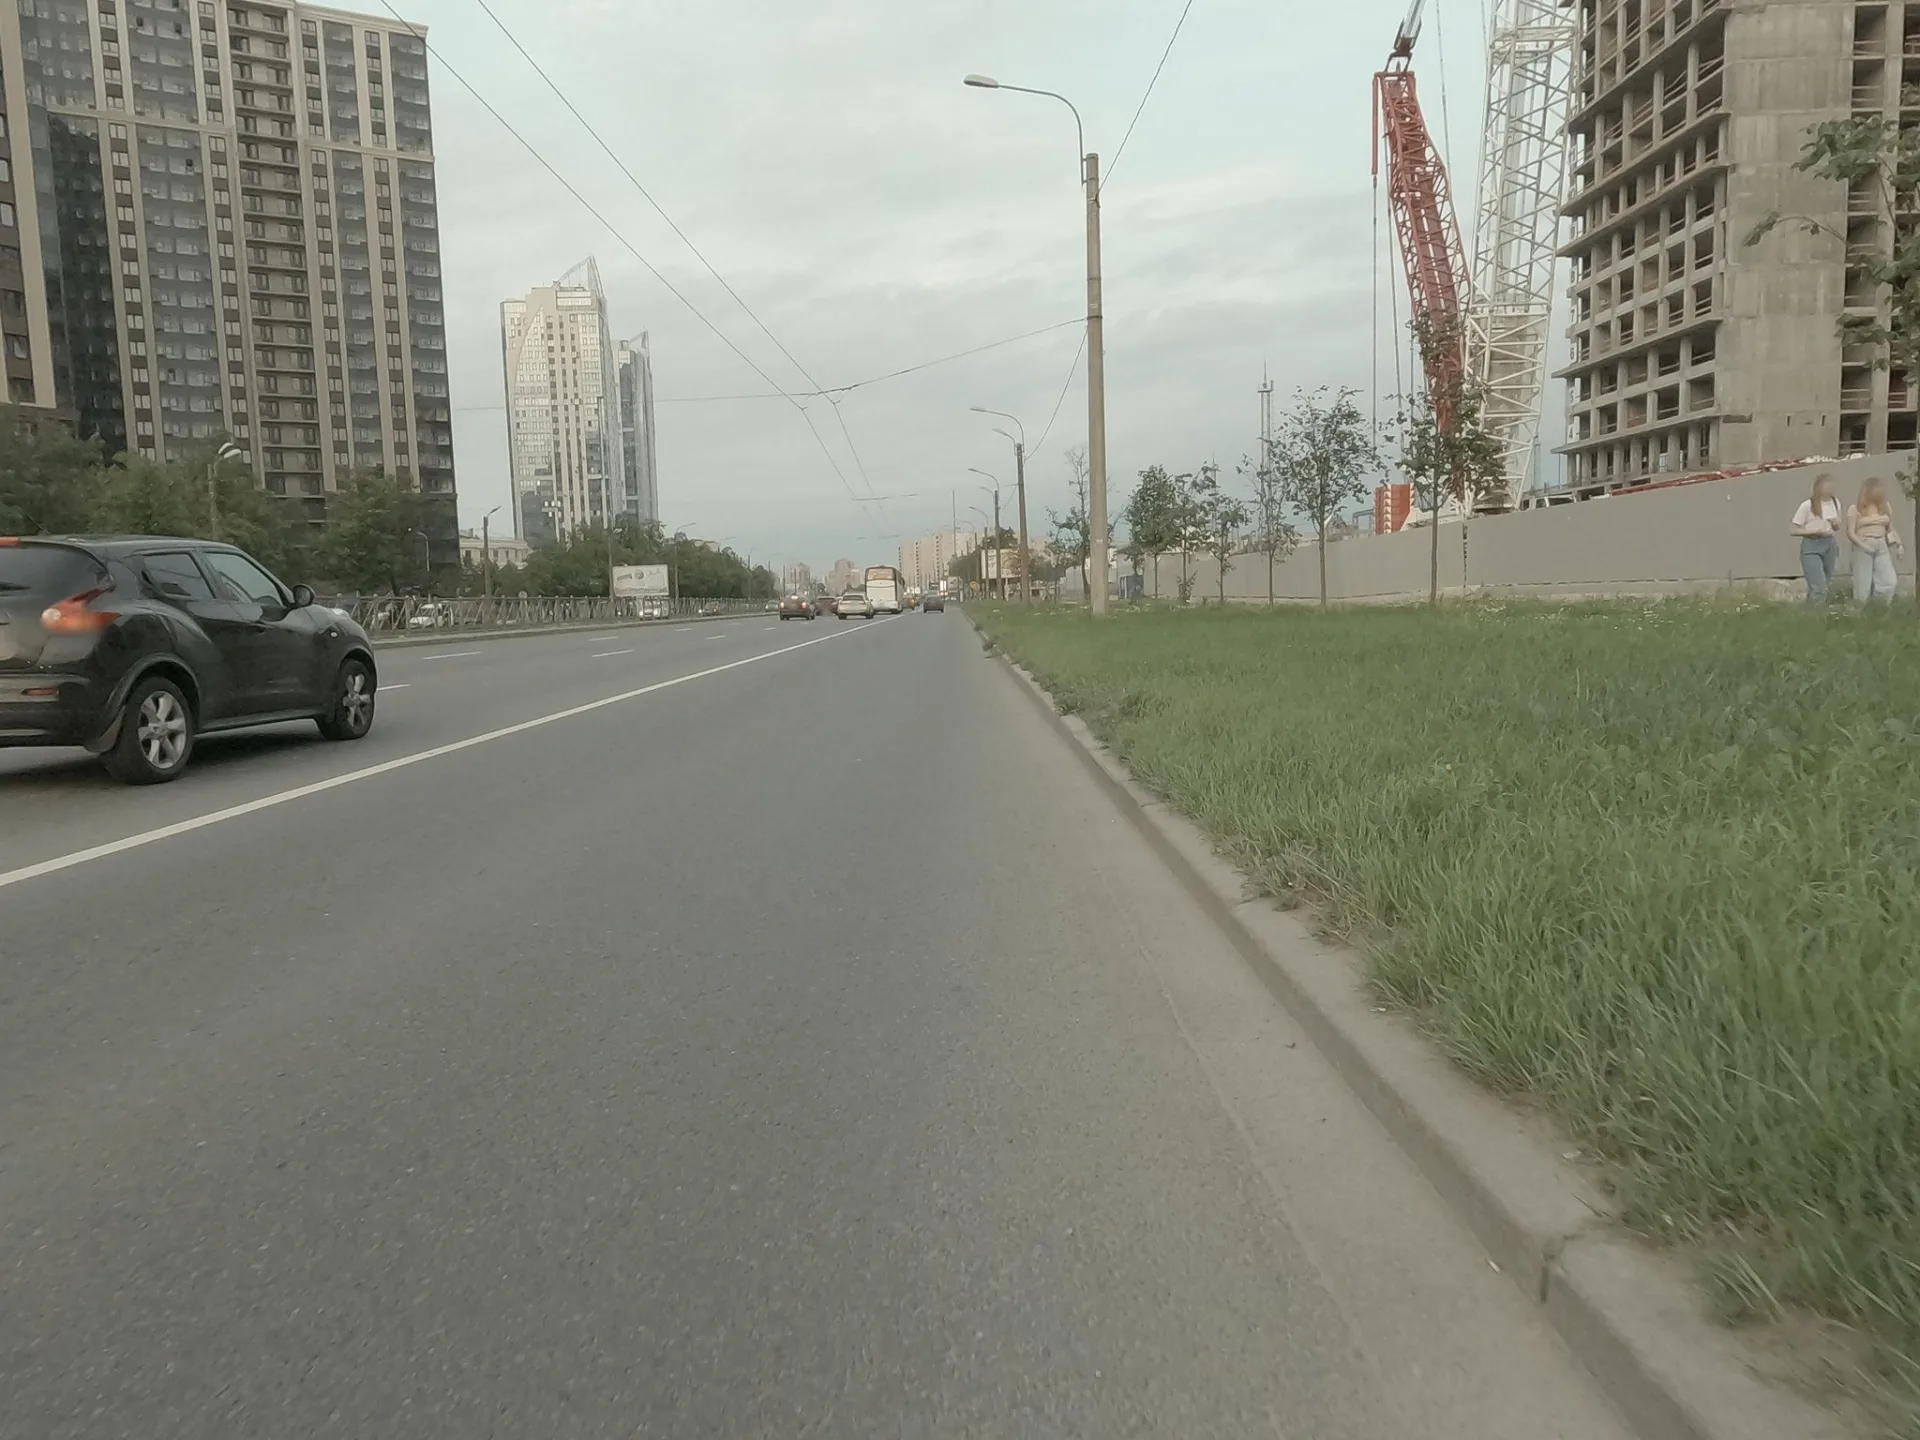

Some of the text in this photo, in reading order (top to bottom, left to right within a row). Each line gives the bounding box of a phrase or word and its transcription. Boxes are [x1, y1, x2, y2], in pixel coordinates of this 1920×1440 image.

[1570, 308, 1576, 322] 7
[1569, 347, 1575, 361] 6
[1569, 426, 1574, 440] 4
